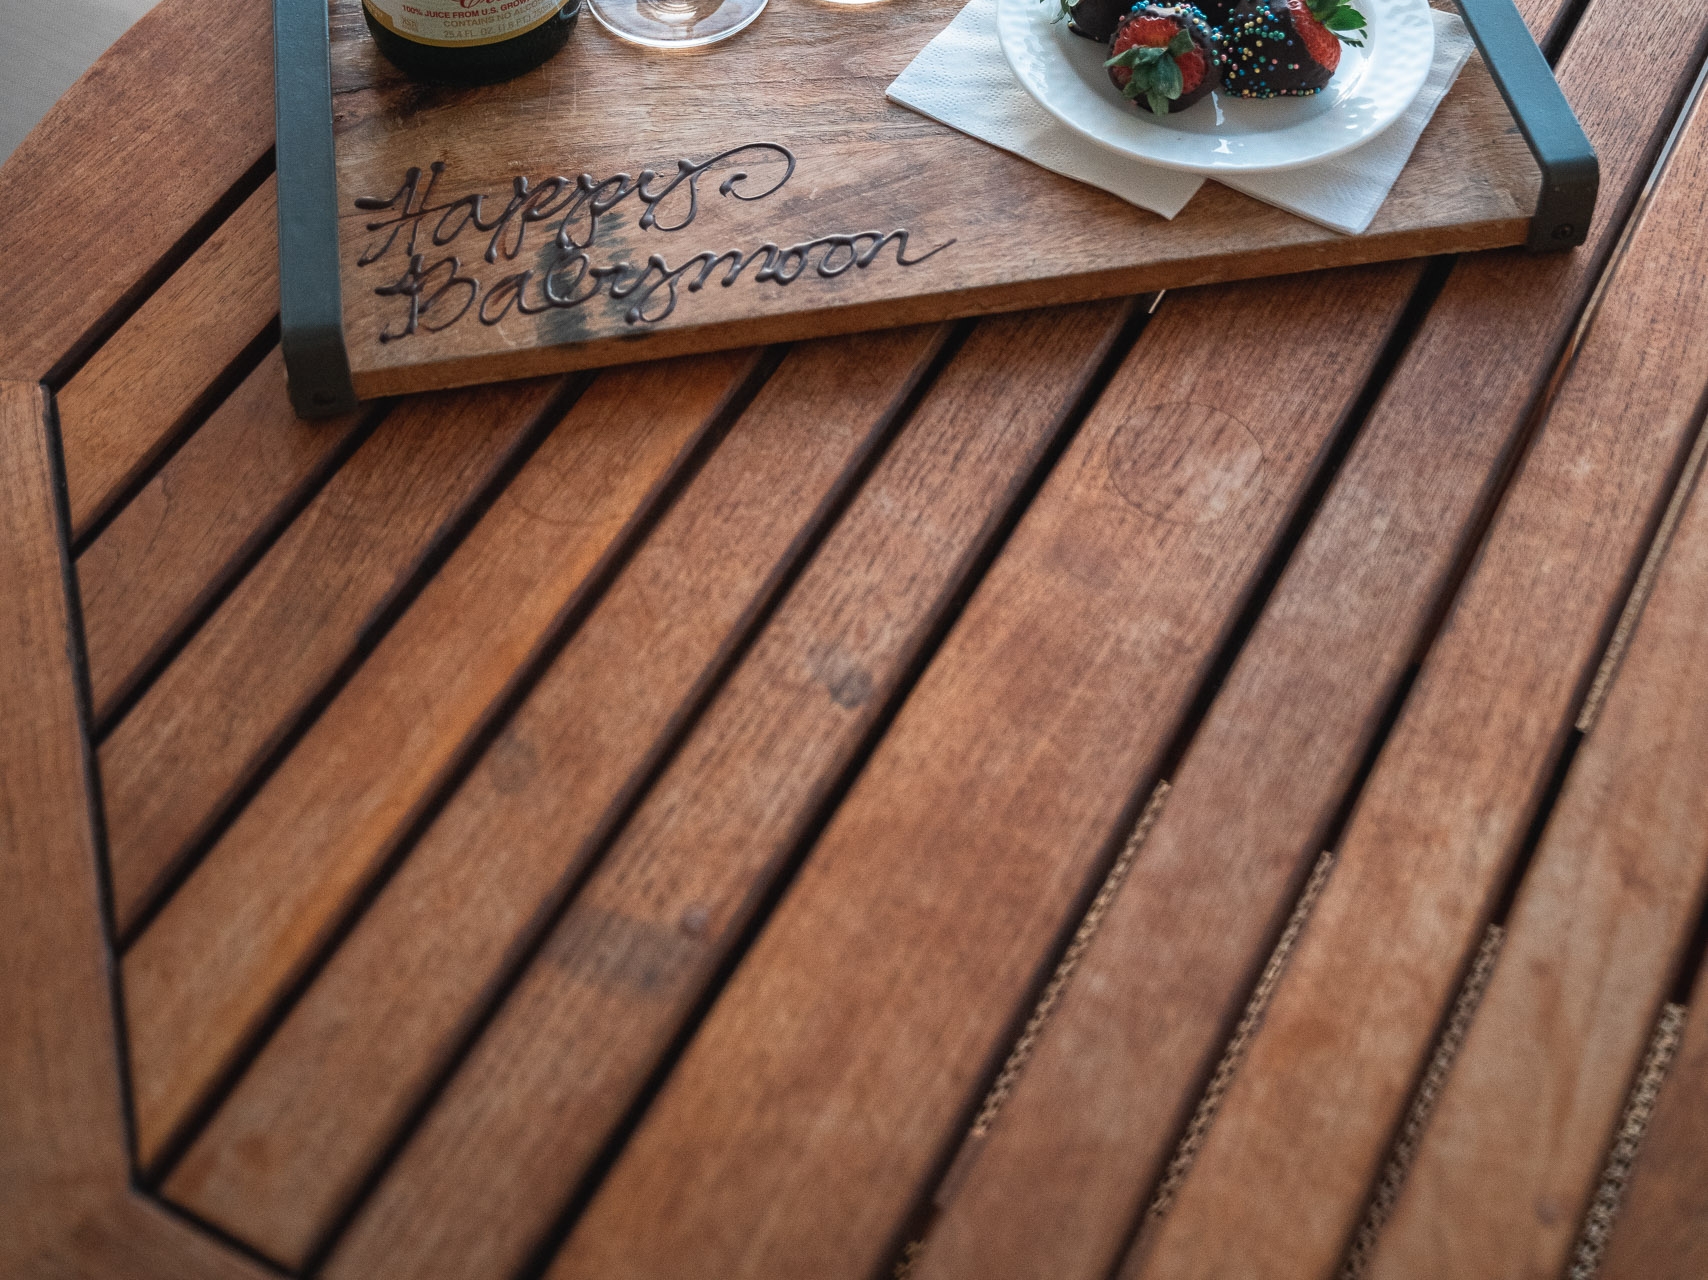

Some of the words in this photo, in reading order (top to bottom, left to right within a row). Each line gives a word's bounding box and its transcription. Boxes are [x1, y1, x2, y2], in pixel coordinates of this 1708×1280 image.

[402, 5, 423, 16] 100%
[425, 10, 450, 19] JUICE
[452, 9, 479, 19] FROM
[481, 6, 499, 16] U.S.
[443, 17, 495, 28] CONTAINS
[497, 12, 511, 22] NO
[354, 142, 796, 267] Happy
[375, 228, 958, 344] Babymoon
